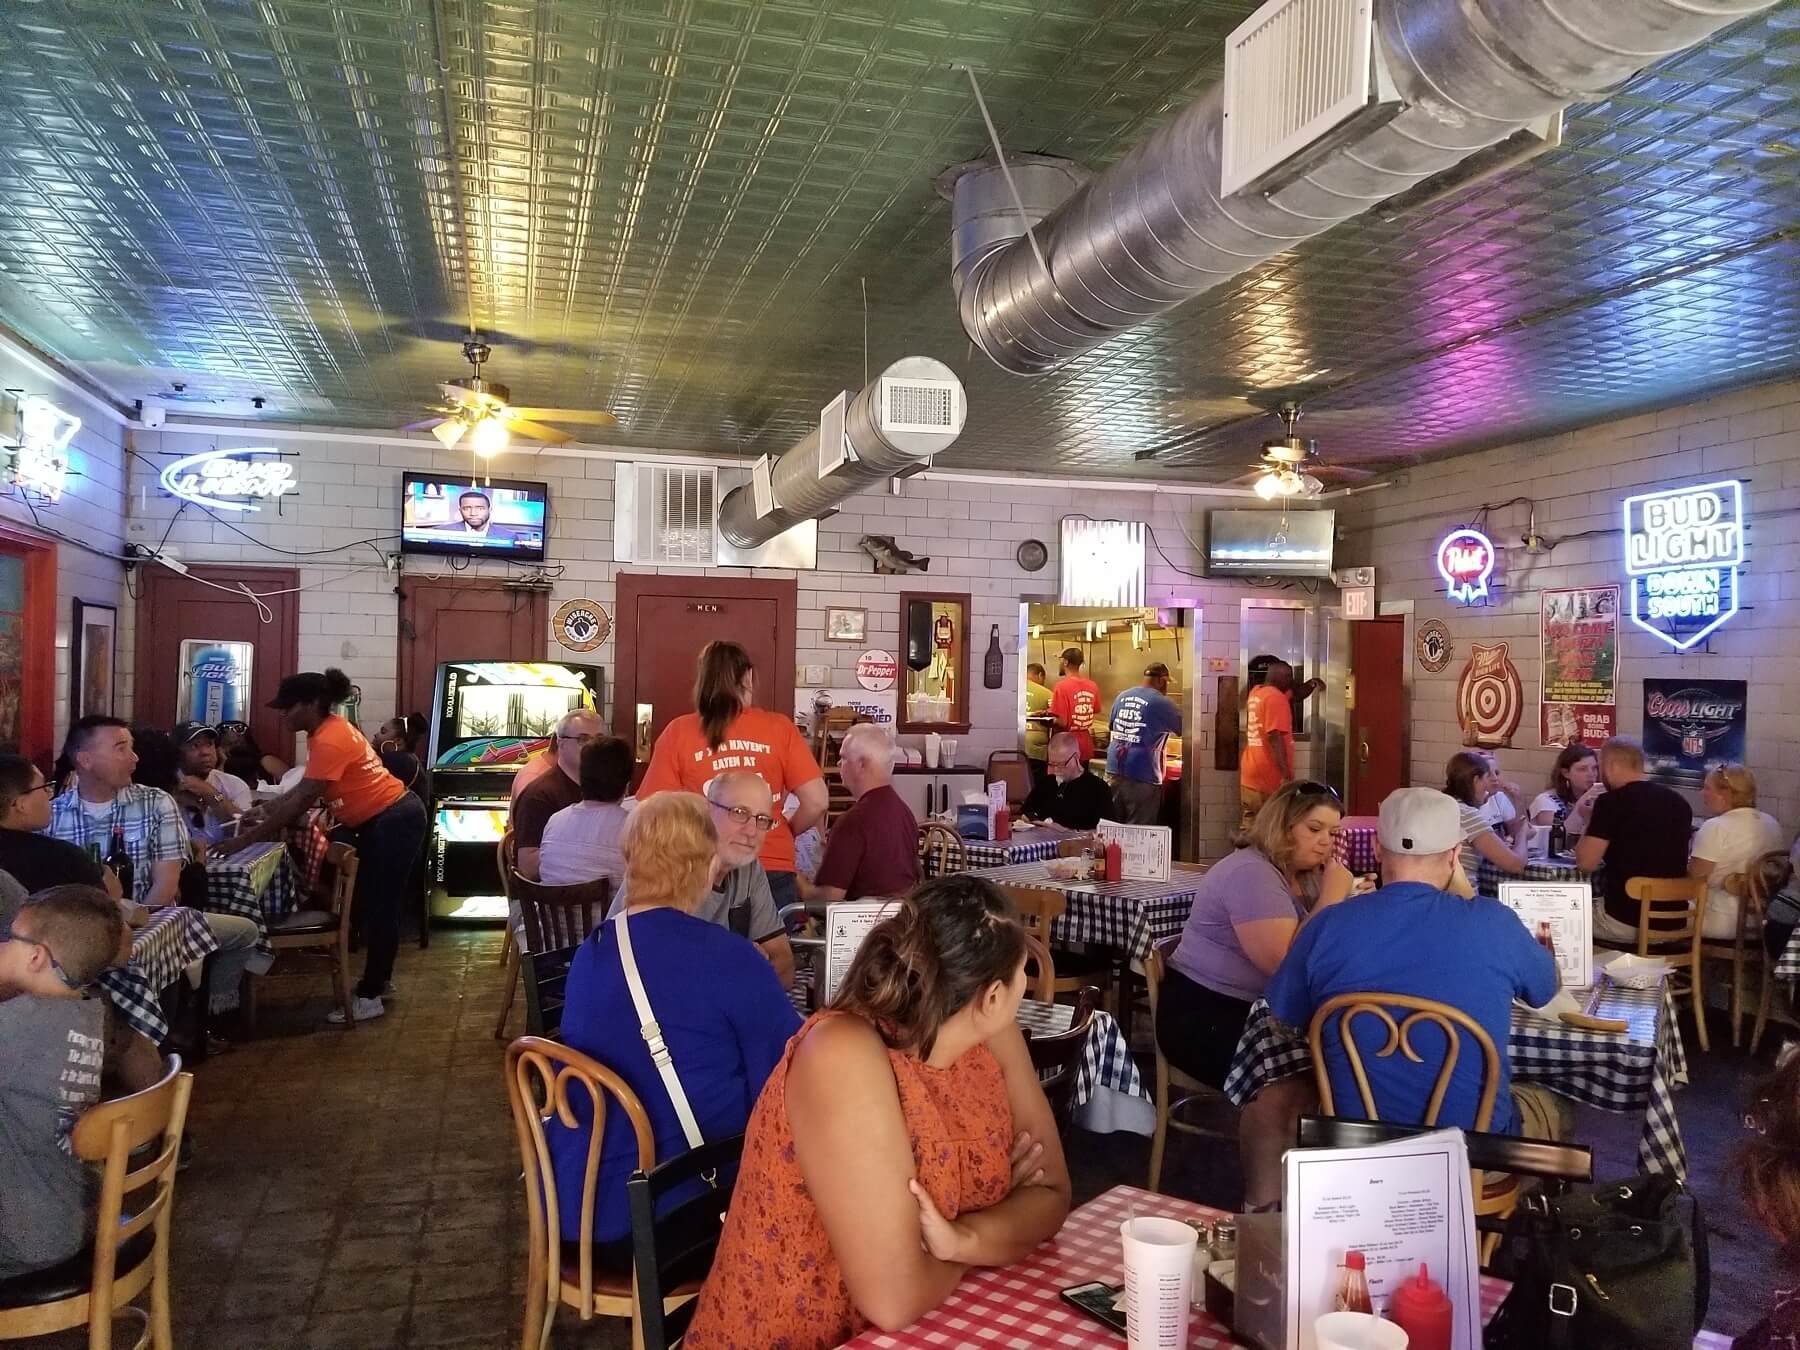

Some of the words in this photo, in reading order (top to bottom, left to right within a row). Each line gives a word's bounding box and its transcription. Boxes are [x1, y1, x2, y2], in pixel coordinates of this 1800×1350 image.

[1643, 491, 1721, 534] BUD
[1631, 522, 1737, 567] LIGHT
[697, 604, 717, 612] MEN
[1647, 593, 1720, 619] SOUTH
[1583, 714, 1610, 724] GRAB
[1691, 703, 1742, 720] LIGHT
[1583, 728, 1610, 738] BUDS
[729, 739, 771, 755] HAVEN'T
[712, 756, 741, 771] EATEN
[743, 756, 756, 768] AT
